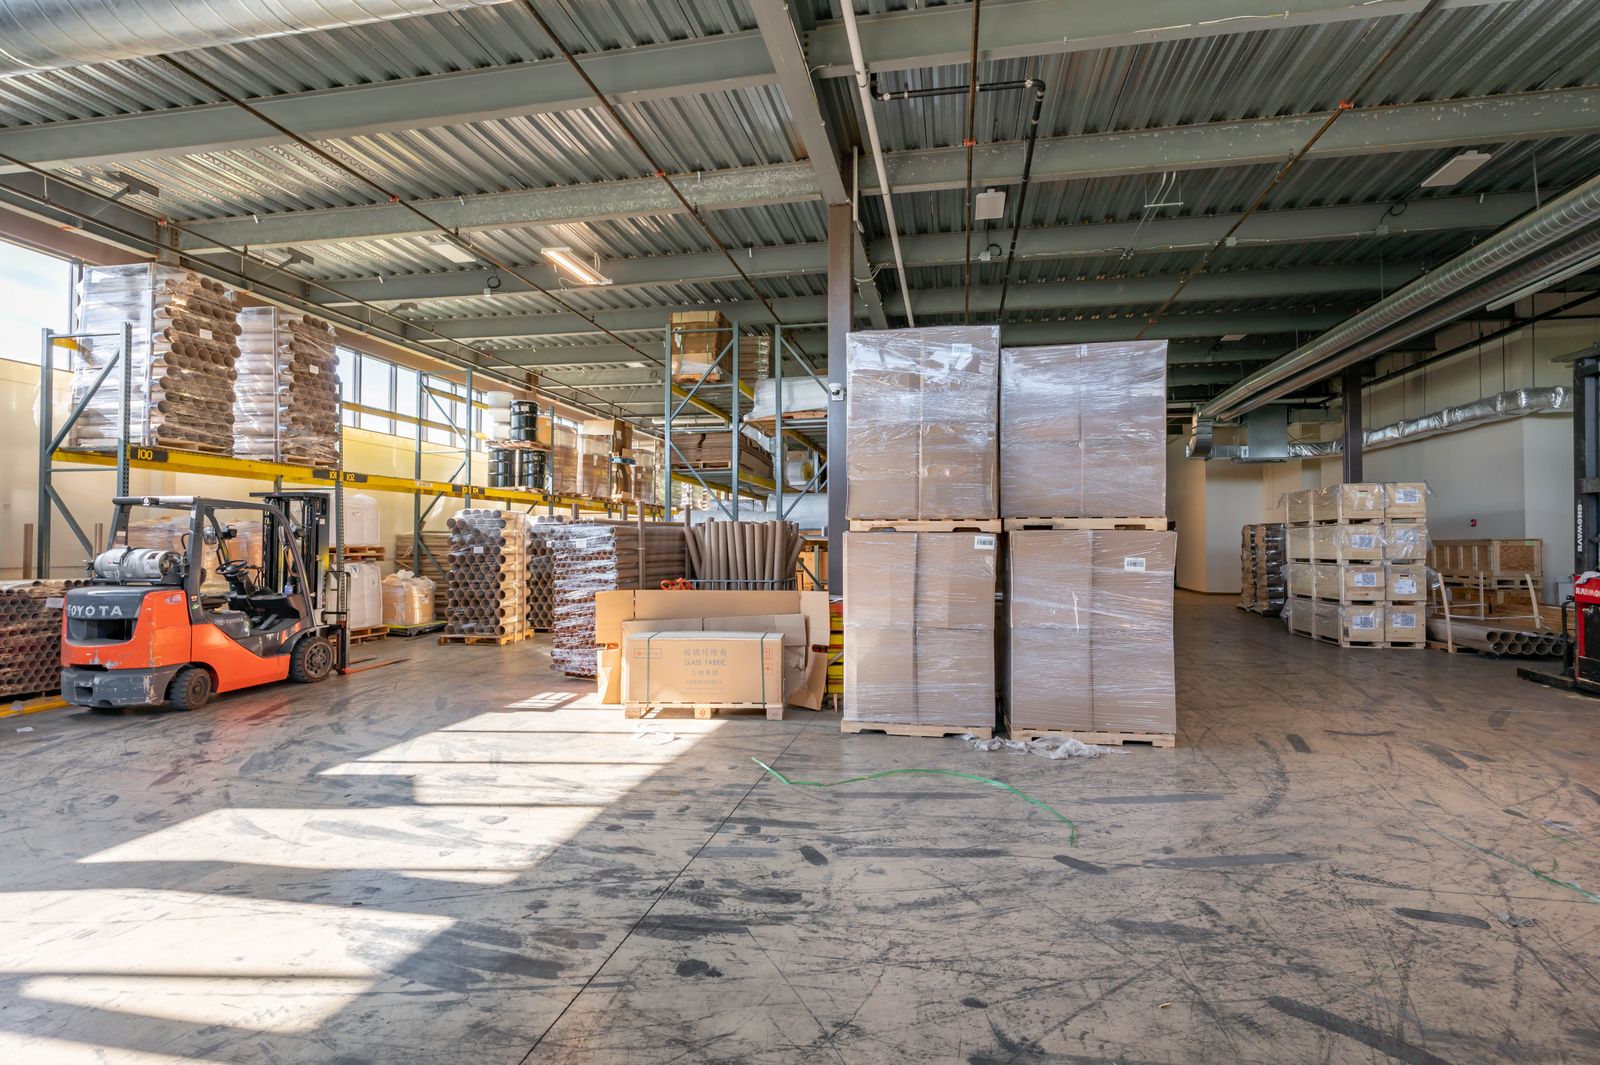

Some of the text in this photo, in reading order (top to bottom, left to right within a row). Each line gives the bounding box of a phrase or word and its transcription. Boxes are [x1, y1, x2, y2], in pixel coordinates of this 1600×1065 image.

[137, 448, 153, 460] 100
[683, 658, 727, 666] GLASS FABRIC
